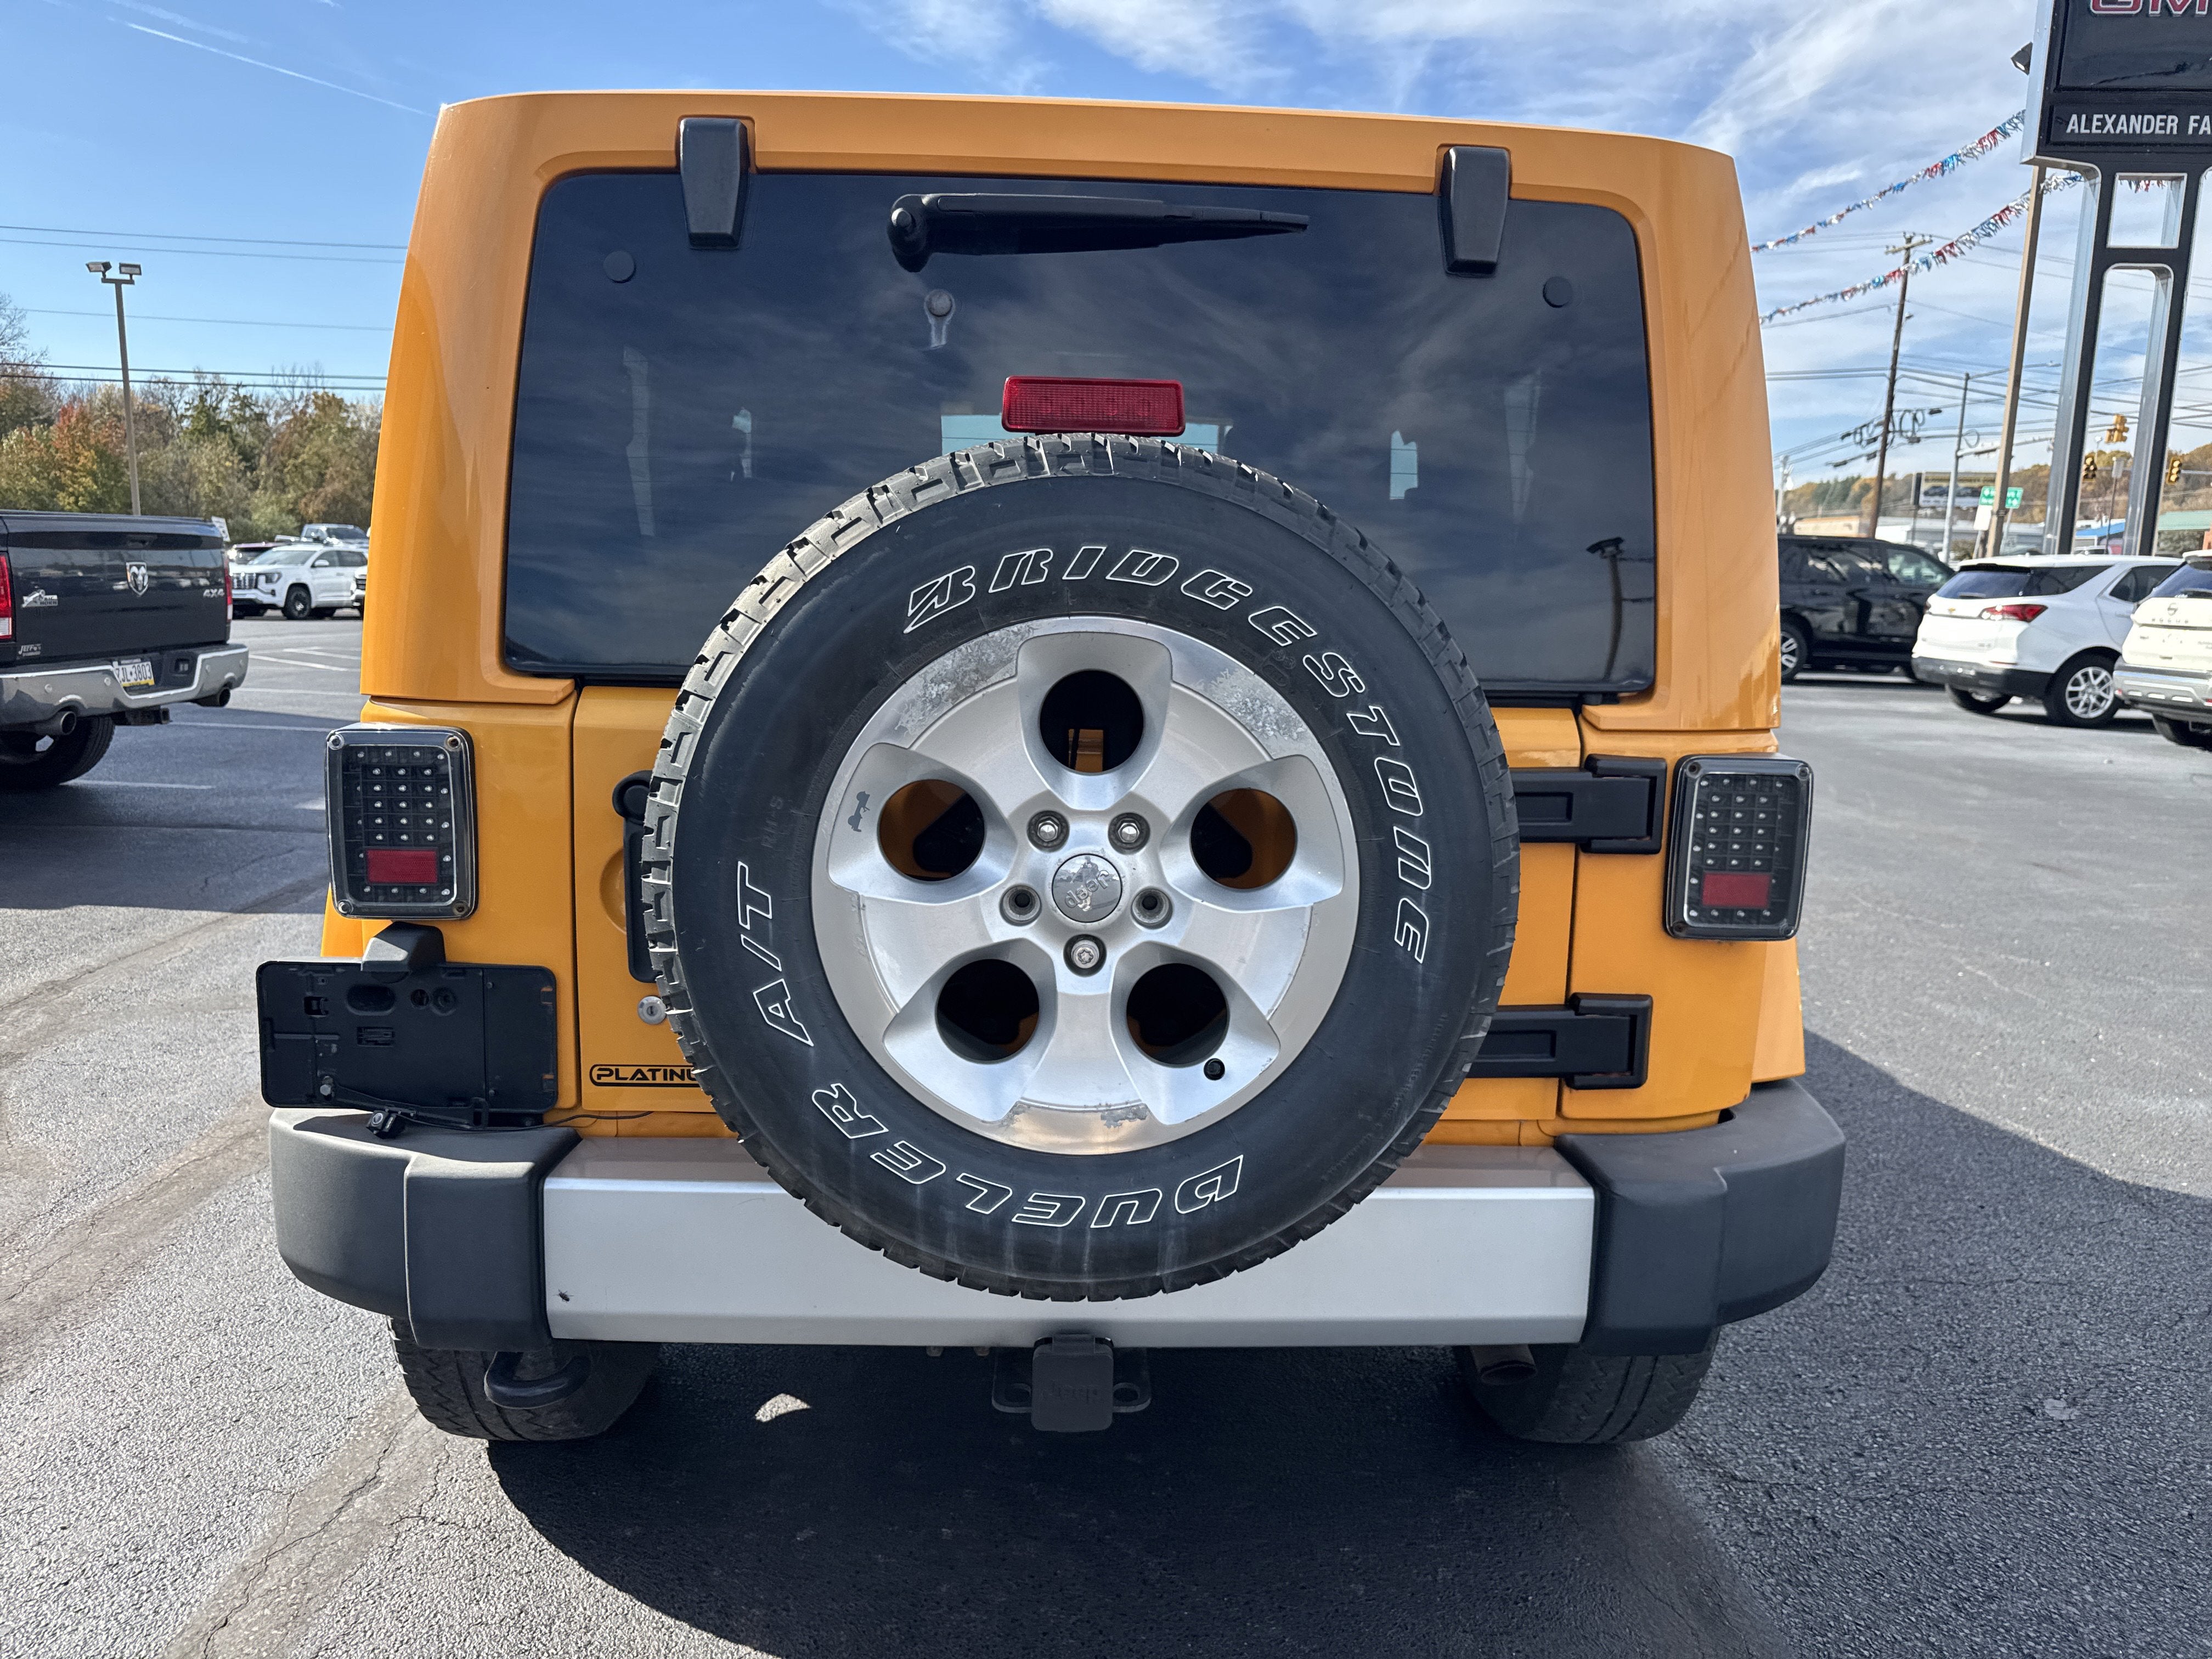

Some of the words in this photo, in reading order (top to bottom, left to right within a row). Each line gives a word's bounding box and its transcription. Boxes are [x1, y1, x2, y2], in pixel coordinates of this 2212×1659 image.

[2066, 114, 2179, 135] ALEXANDER
[2187, 115, 2211, 135] FA
[902, 545, 1432, 964] BRIDGESTONE
[737, 861, 814, 1047] A/T
[1064, 869, 1110, 909] Jeep
[811, 1083, 1244, 1229] DUELER
